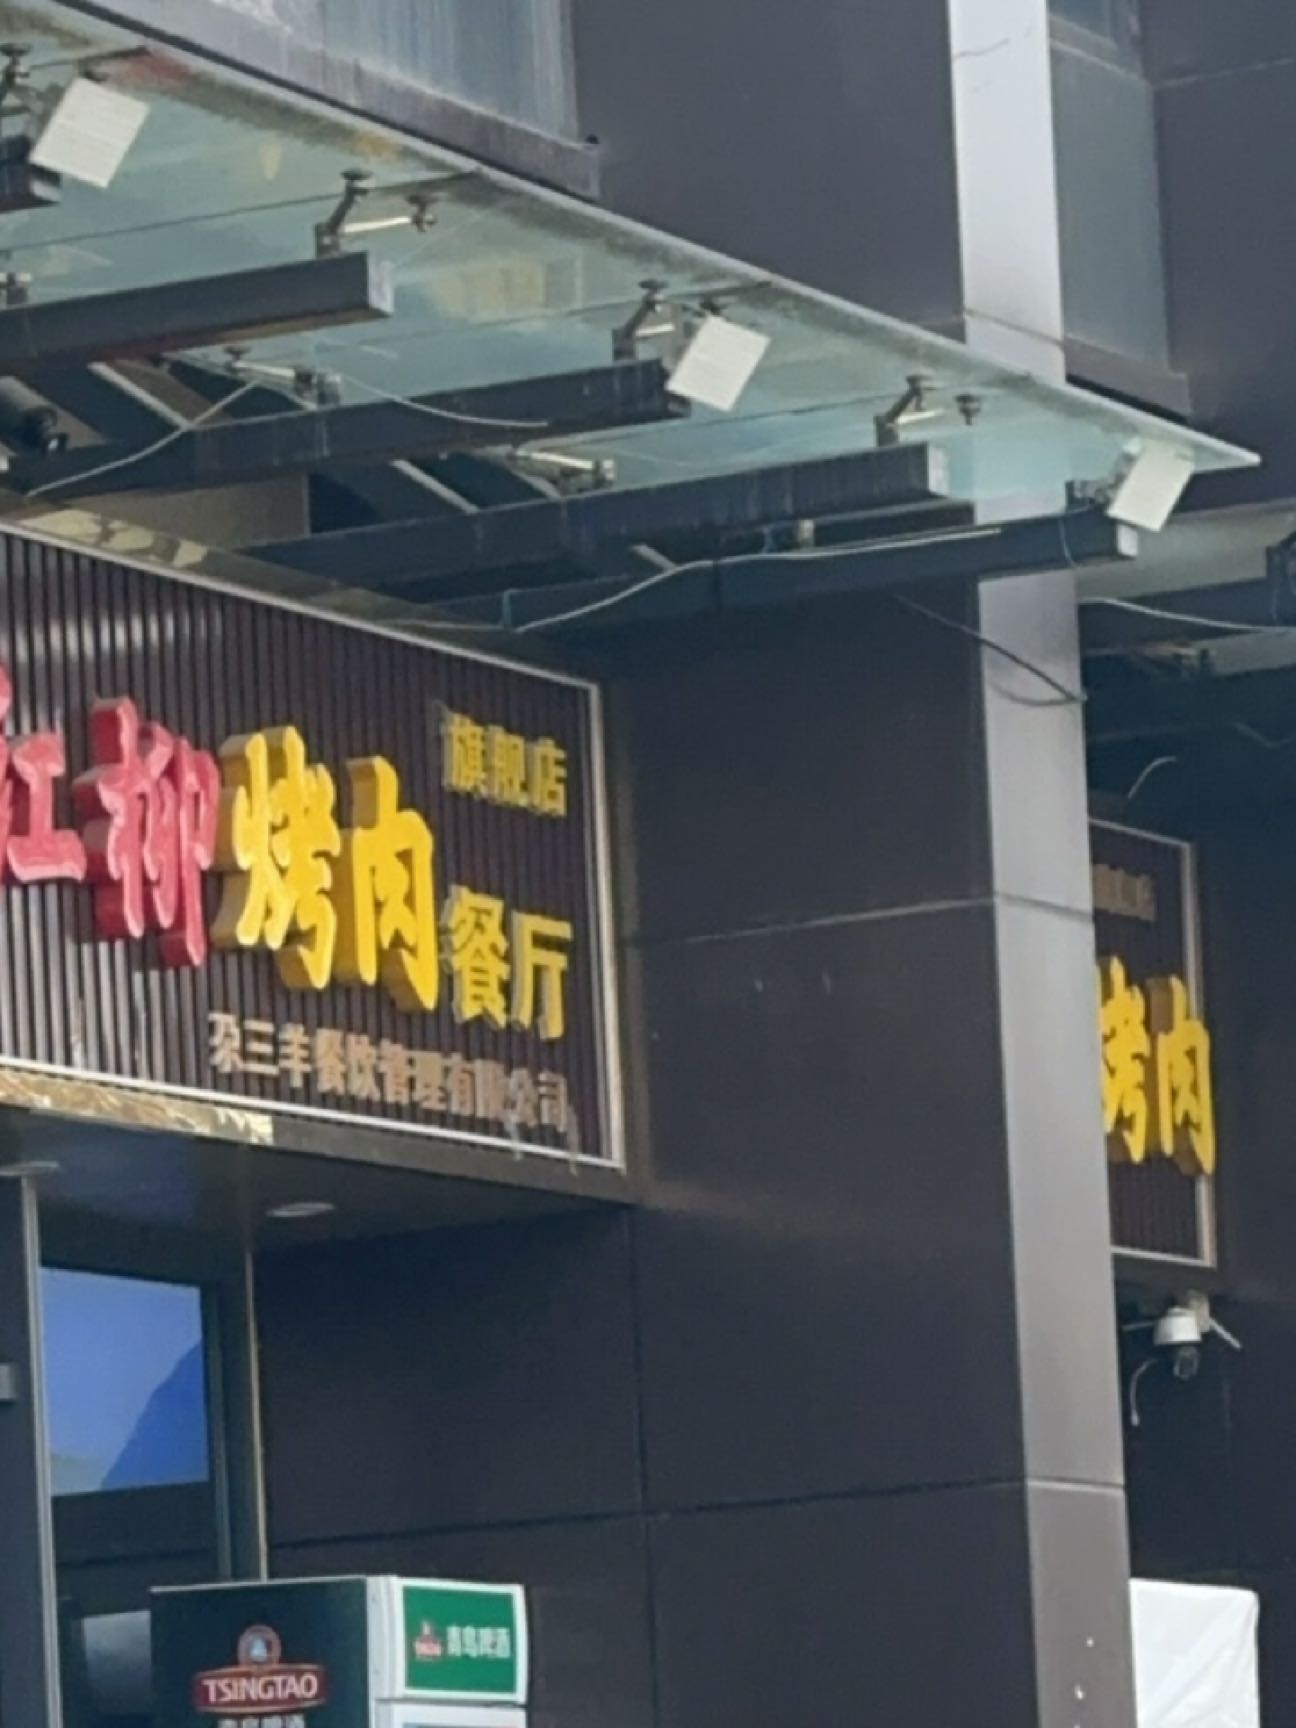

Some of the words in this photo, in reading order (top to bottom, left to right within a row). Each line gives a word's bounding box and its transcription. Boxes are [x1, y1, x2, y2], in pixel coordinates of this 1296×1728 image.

[442, 704, 568, 818] 旗舰店
[442, 884, 572, 1040] 餐厅
[1096, 955, 1217, 1176] 烤肉
[202, 1672, 318, 1704] TSINGTAO
